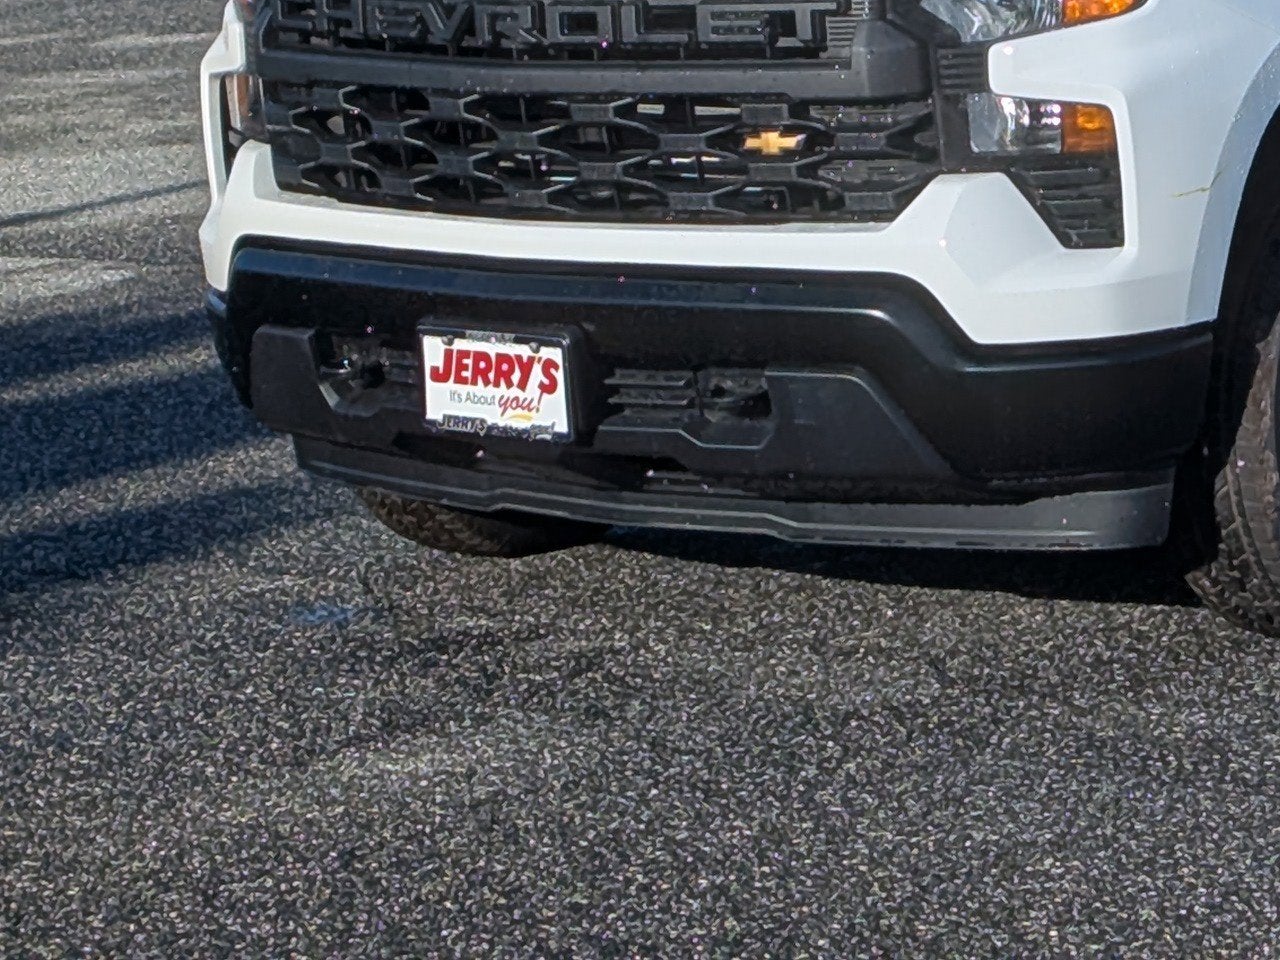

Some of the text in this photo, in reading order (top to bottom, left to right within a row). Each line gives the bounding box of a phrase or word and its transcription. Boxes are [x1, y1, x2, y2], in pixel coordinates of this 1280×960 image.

[429, 347, 560, 395] JERRY'S
[464, 391, 496, 406] About
[498, 390, 544, 417] you!
